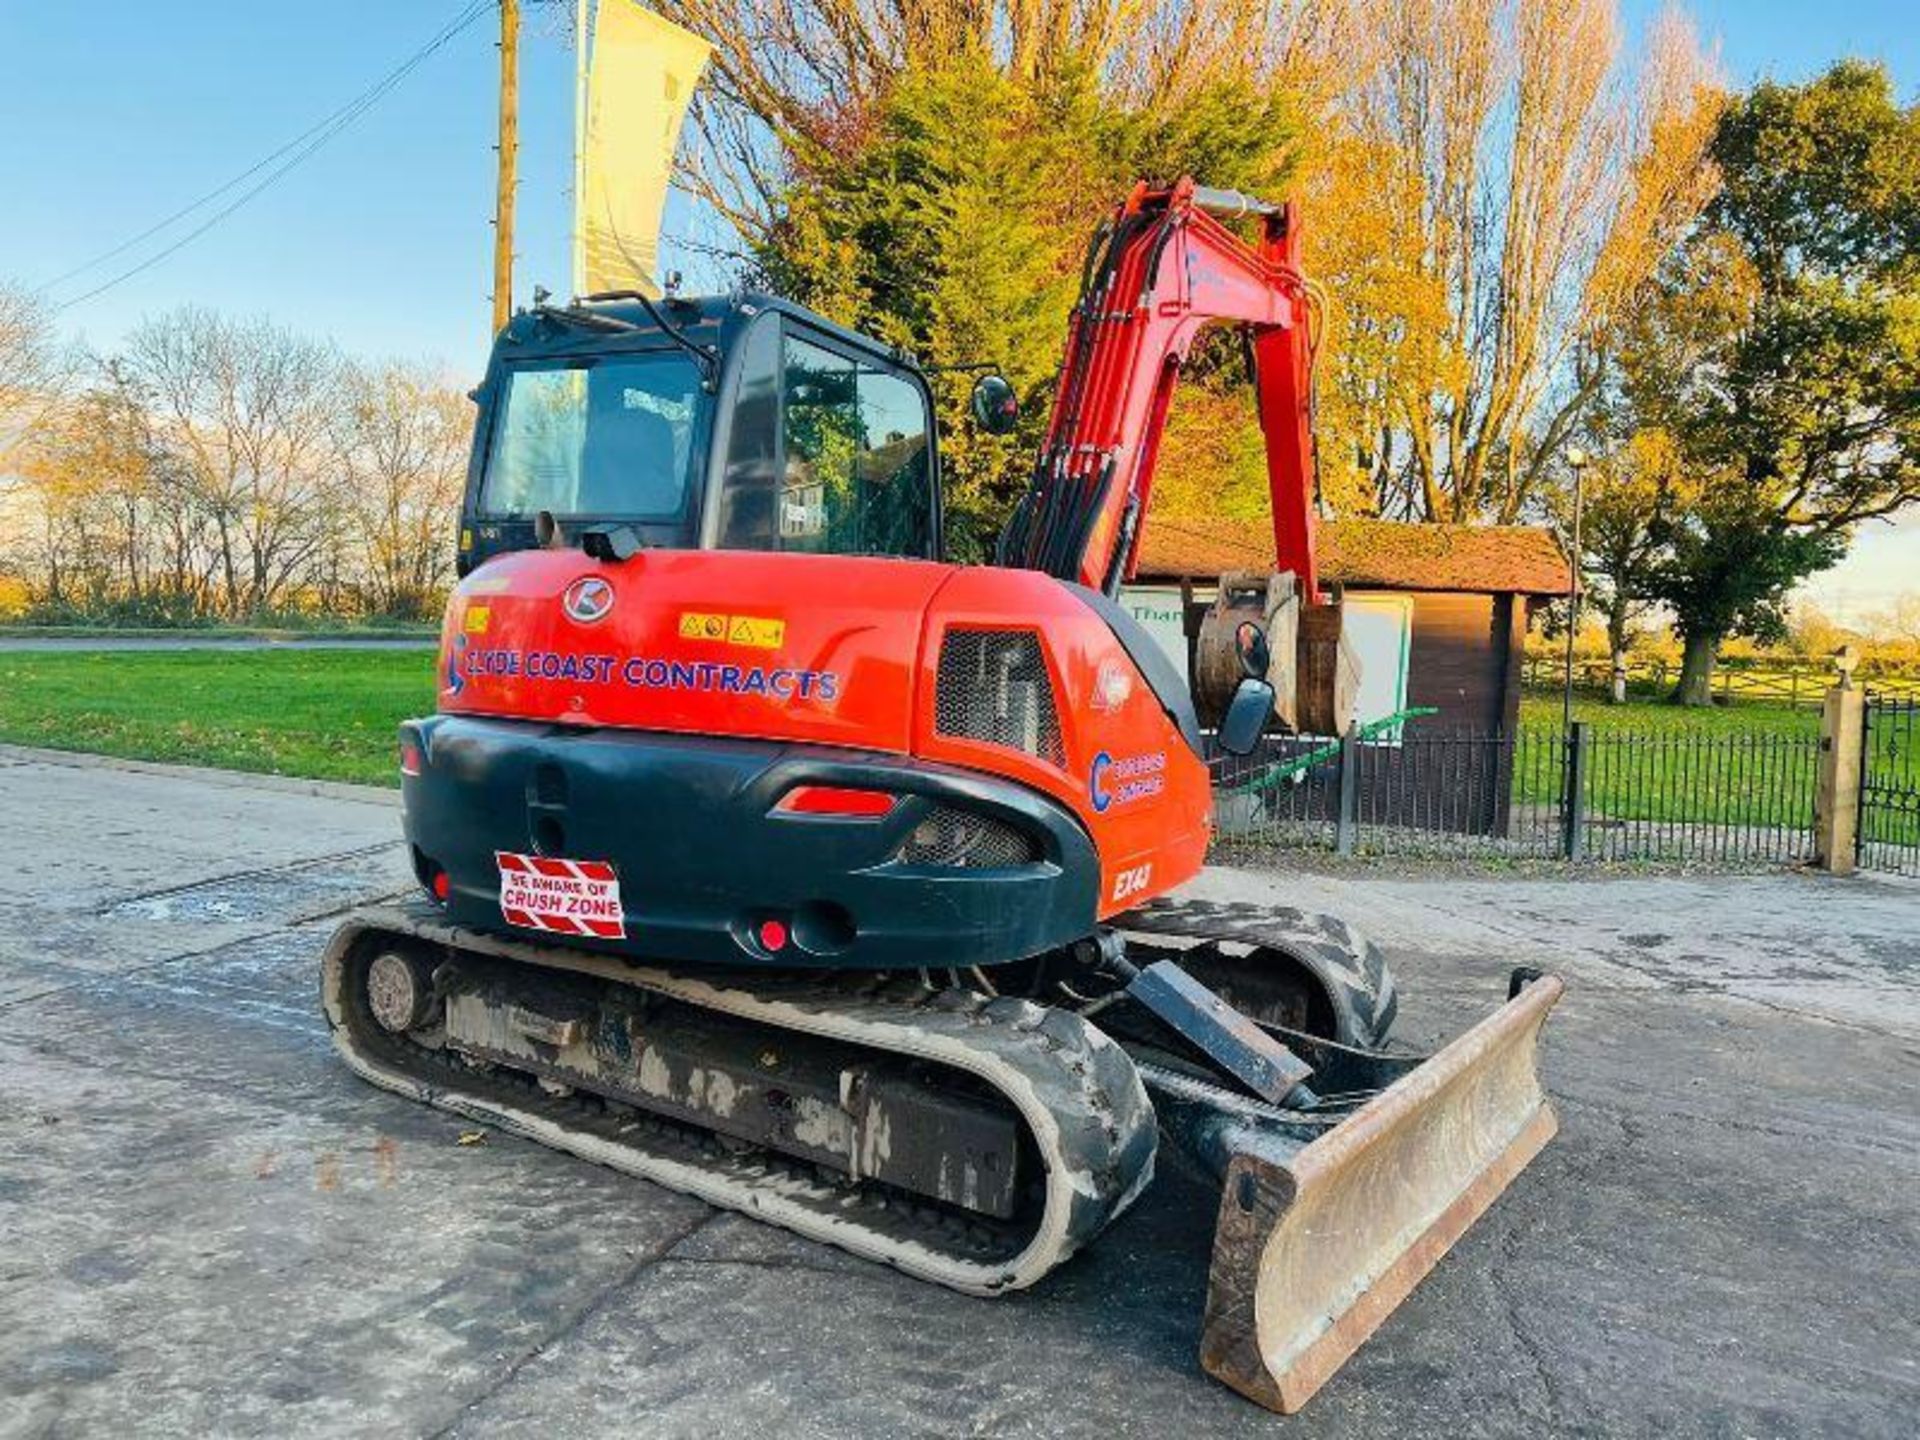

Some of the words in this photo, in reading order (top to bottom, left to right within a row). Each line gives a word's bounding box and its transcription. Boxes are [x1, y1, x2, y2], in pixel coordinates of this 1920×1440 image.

[526, 653, 616, 683] COAST
[624, 658, 838, 700] CONTRACTS
[510, 873, 528, 888] BE
[505, 889, 561, 912] CRUSH
[566, 897, 619, 917] ZONE
